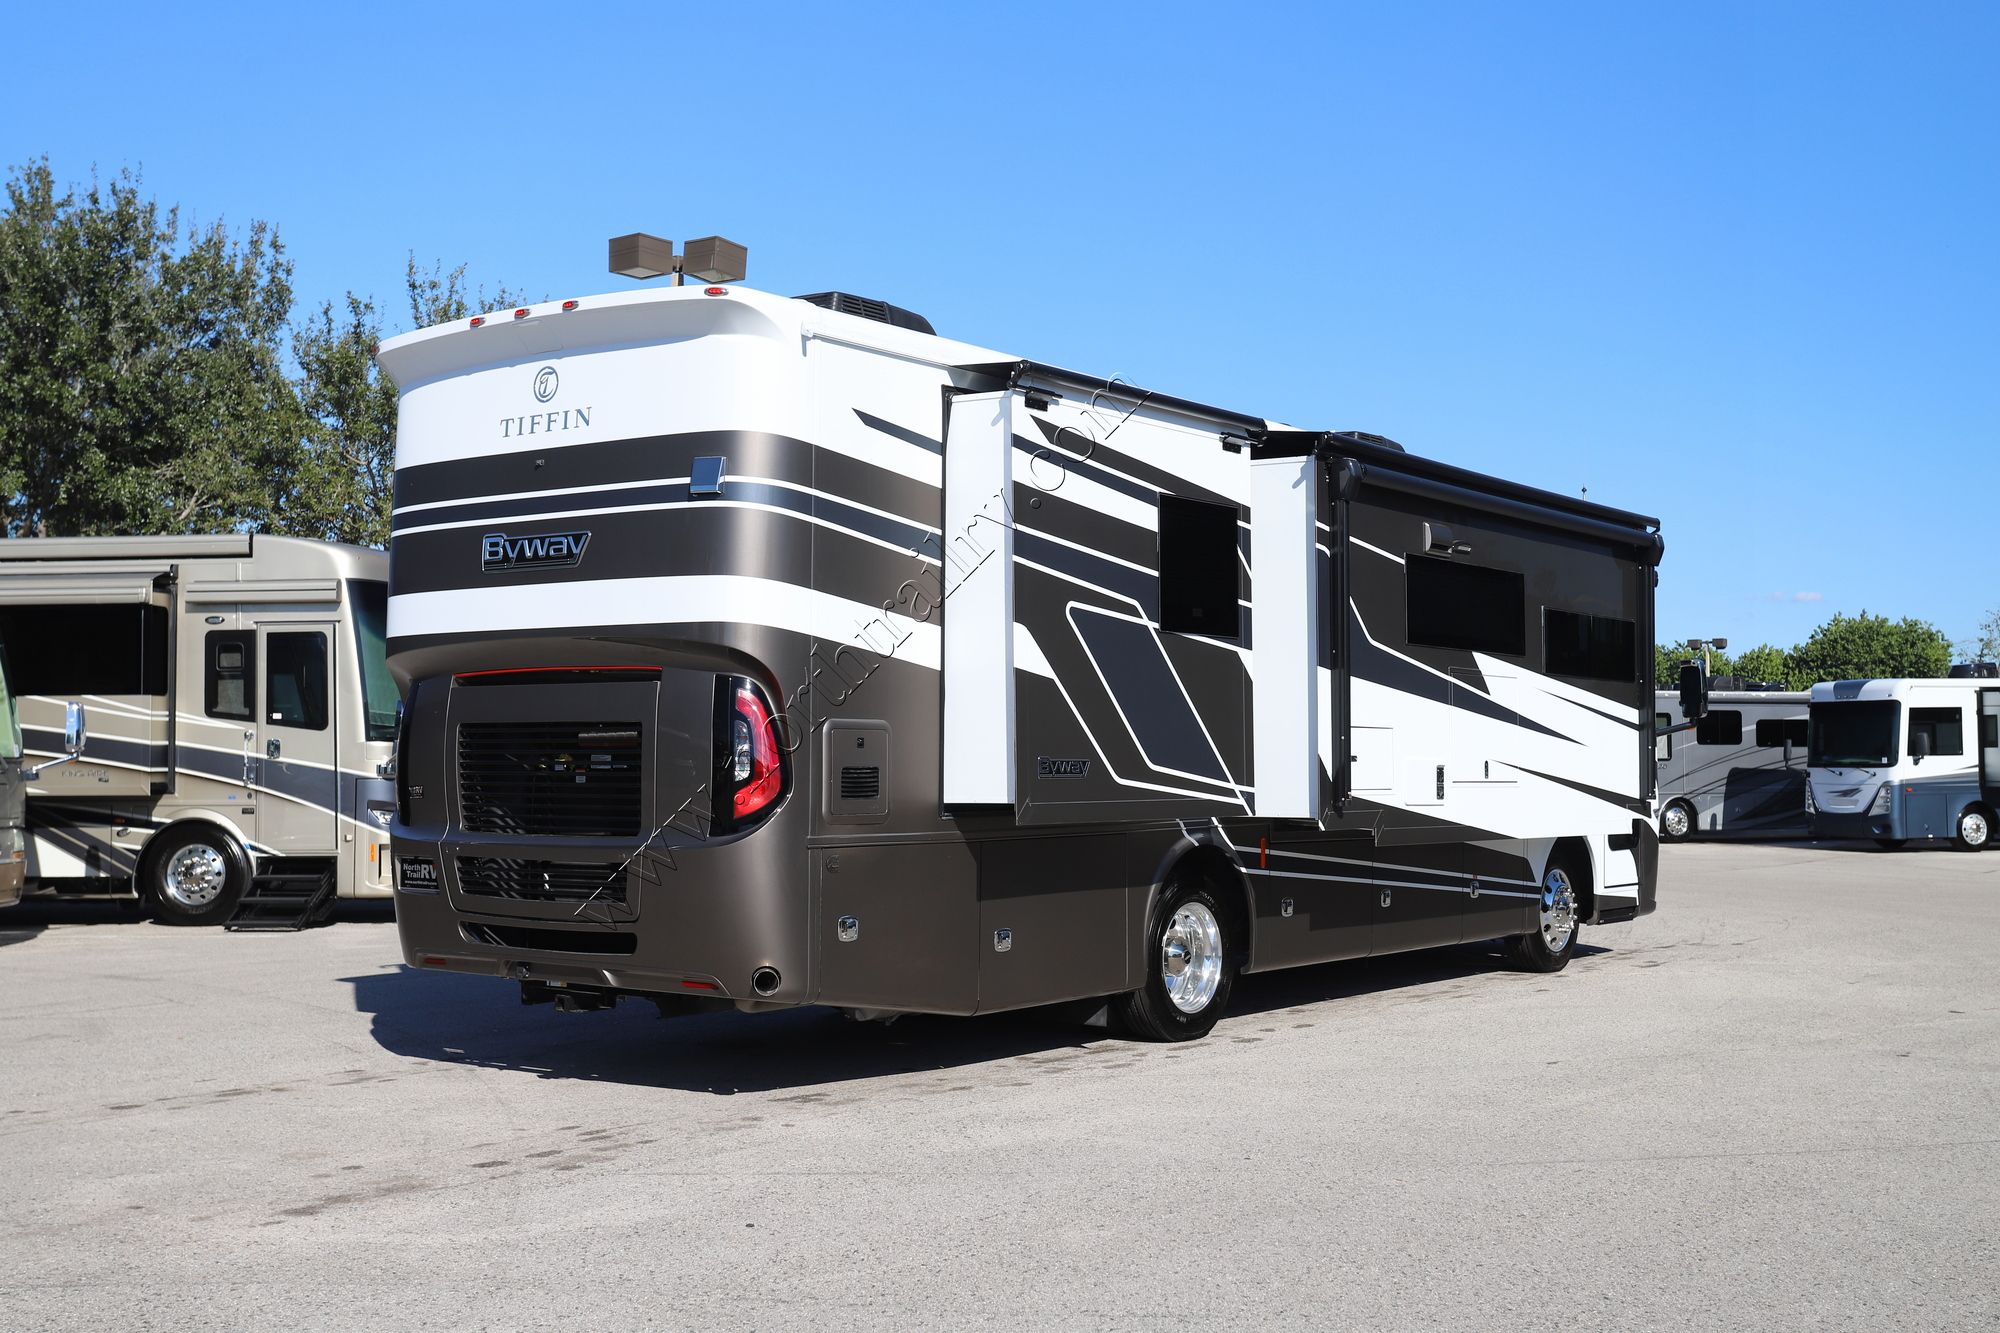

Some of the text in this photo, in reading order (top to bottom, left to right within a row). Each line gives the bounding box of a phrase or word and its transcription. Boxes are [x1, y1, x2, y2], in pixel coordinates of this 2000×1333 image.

[500, 406, 592, 438] TIFFIN
[484, 534, 587, 566] Byway
[403, 863, 420, 871] North
[407, 870, 420, 878] Trail
[420, 864, 437, 879] RV
